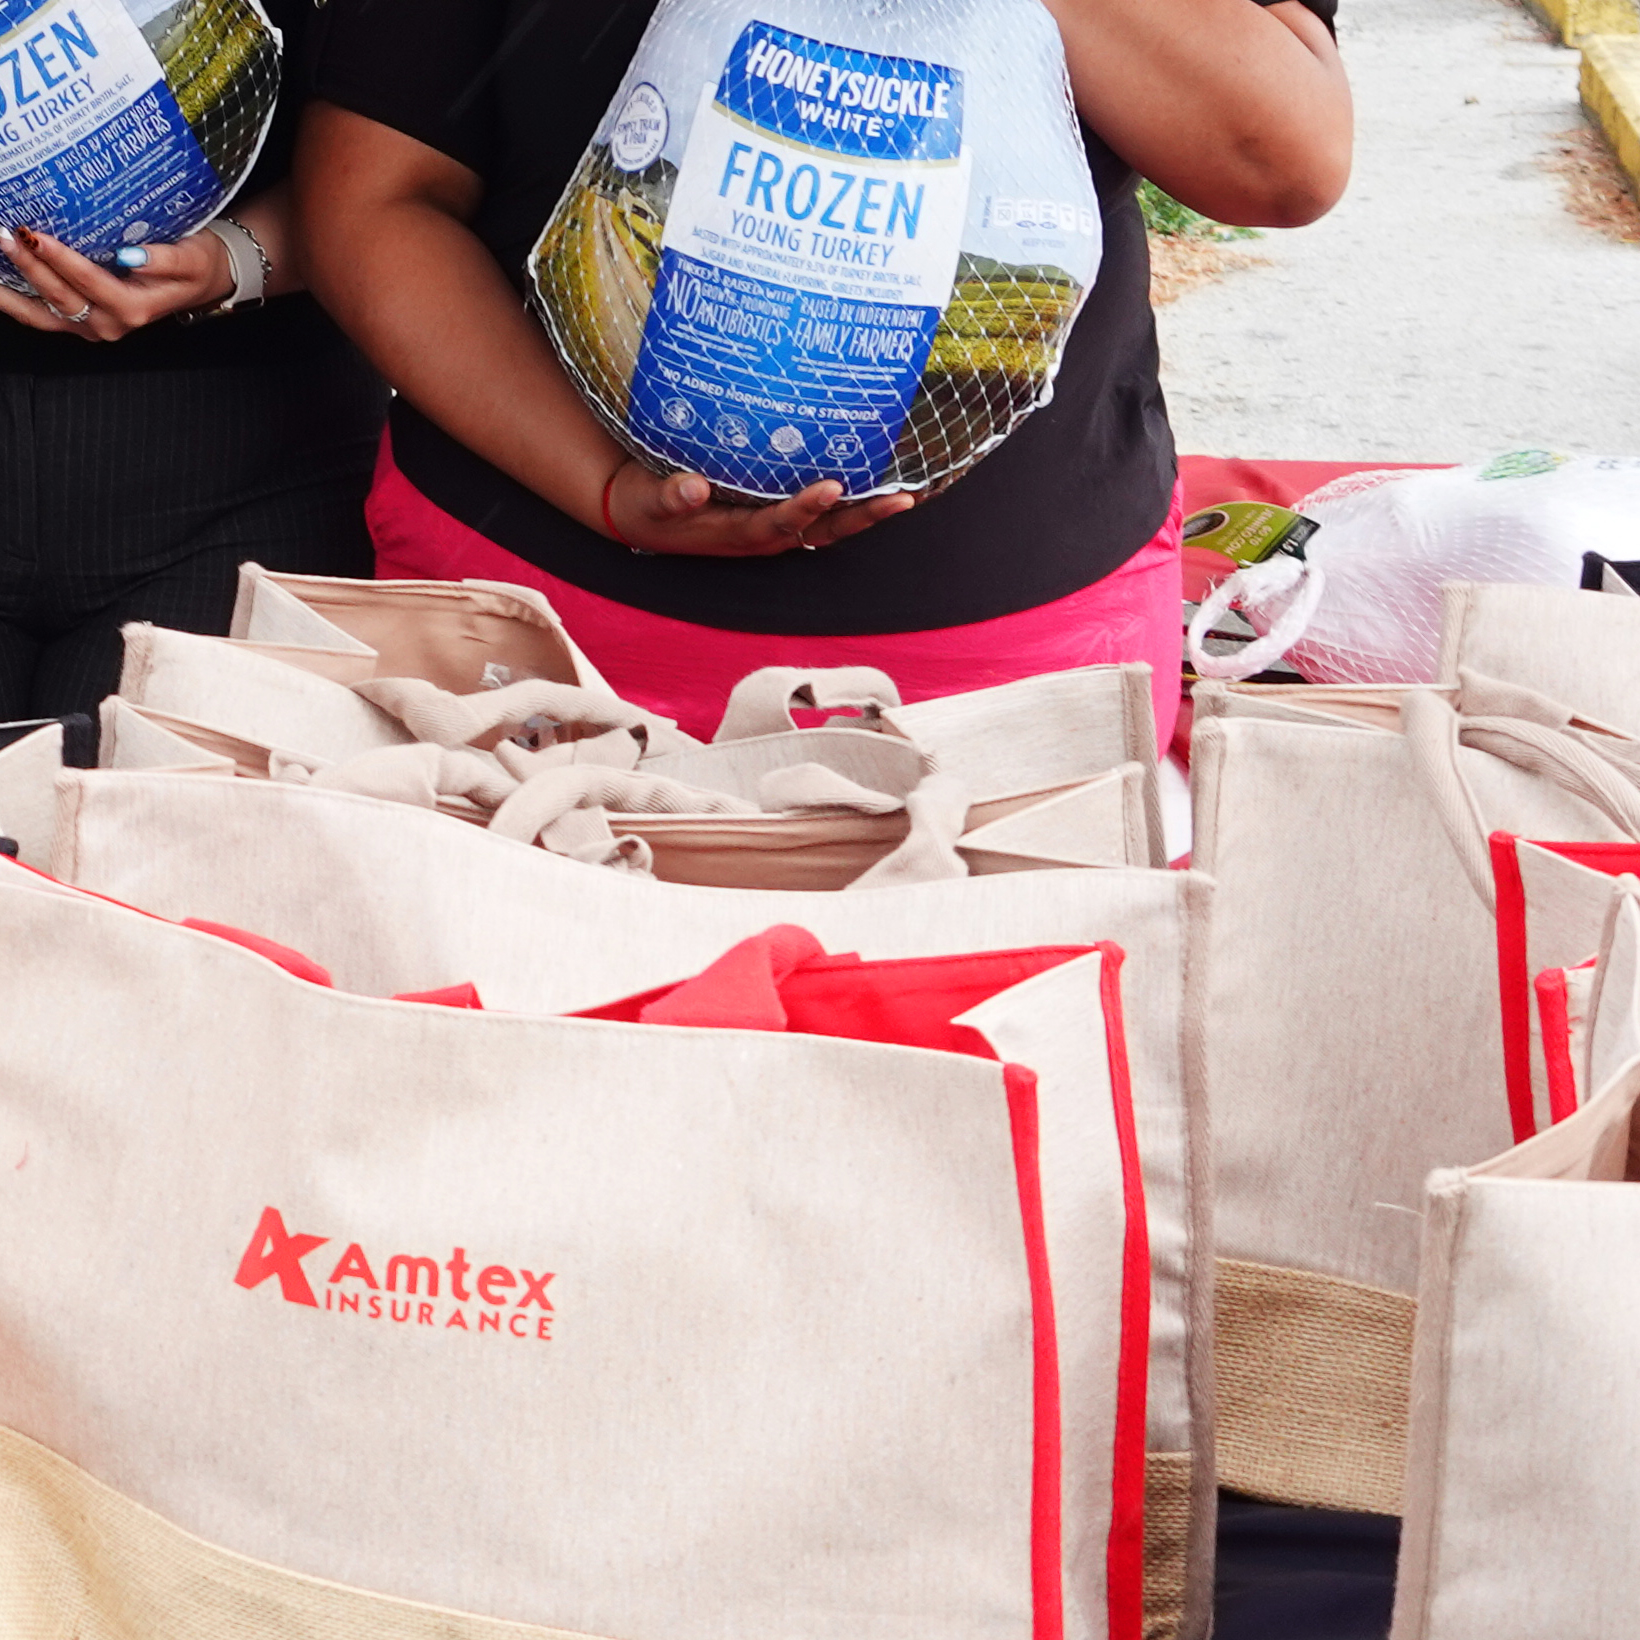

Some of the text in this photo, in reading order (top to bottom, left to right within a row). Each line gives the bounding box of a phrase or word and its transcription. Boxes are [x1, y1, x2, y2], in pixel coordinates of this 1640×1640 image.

[19, 73, 97, 135] TURKEY
[744, 37, 953, 122] HONEYSUCKLE
[52, 121, 64, 134] OF
[62, 103, 90, 128] TURKEY
[54, 142, 90, 173] RAISED
[99, 91, 160, 146] INDEPENDENT
[64, 149, 118, 197] FAMILY
[111, 108, 172, 166] FARMERS
[717, 139, 924, 242] FROZEN
[729, 210, 894, 268] YOUNG TURKEY
[824, 262, 838, 274] OF
[664, 270, 701, 320] NO
[792, 317, 851, 357] FAMILY
[848, 326, 918, 362] FARMERS
[694, 300, 785, 346] ANTIBIOTICS
[722, 274, 761, 296] RAISED
[765, 286, 796, 304] WITH
[799, 296, 839, 320] RAISED
[849, 304, 926, 328] INDEPENDENT
[681, 375, 724, 397] ADDED
[725, 388, 795, 414] HORMONES
[797, 404, 816, 417] OR
[327, 1242, 557, 1312] Amtex
[325, 1288, 554, 1341] INSURANCE
